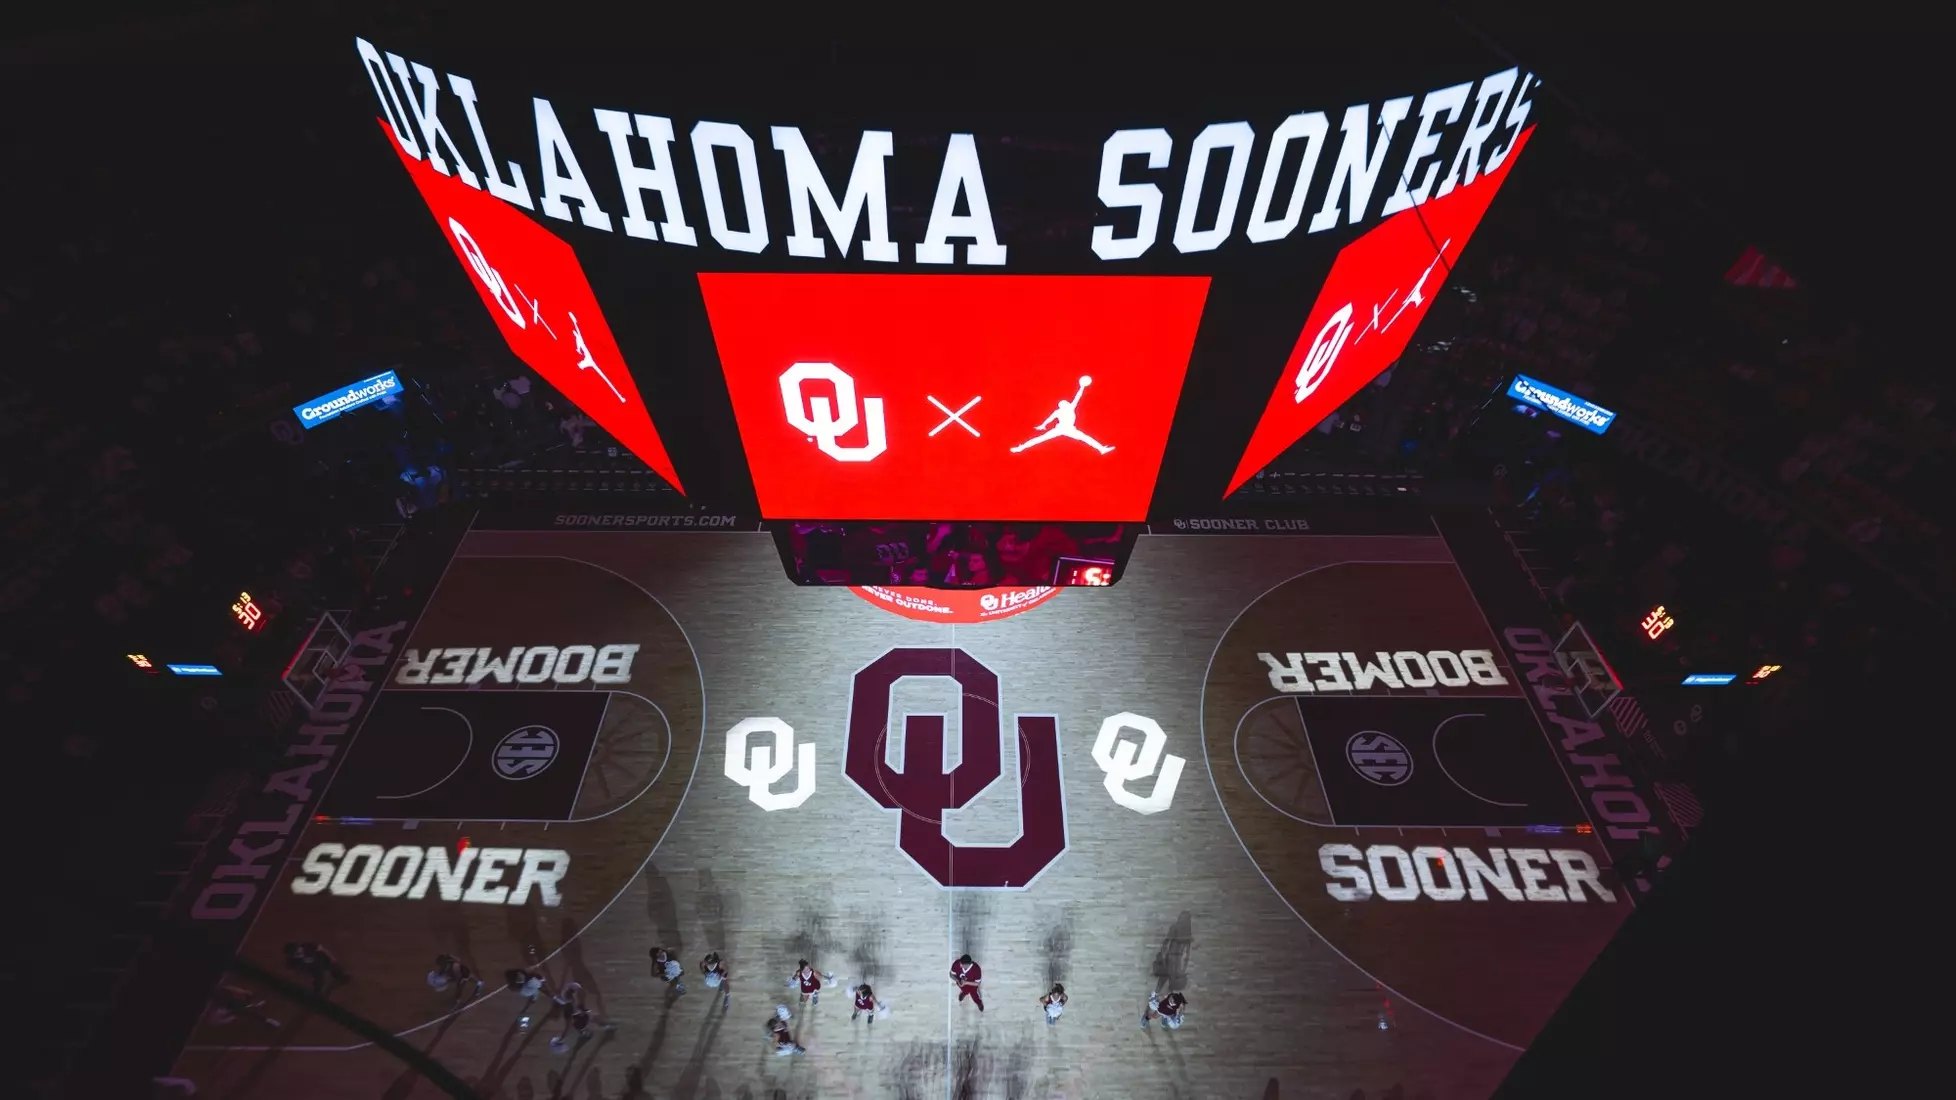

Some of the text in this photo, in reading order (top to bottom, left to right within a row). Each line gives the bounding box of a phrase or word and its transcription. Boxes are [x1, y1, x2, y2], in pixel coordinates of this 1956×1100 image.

[356, 36, 1542, 265] OKLAHOMA SOONERS
[301, 376, 396, 421] Groundworks
[778, 361, 888, 463] OU
[1514, 379, 1609, 427] Groundworks
[554, 514, 736, 527] SOONERSPORTS.COM
[1190, 518, 1260, 530] SOONER
[1265, 519, 1311, 530] CLUB
[238, 602, 262, 630] 30
[1641, 611, 1665, 640] 30
[395, 643, 640, 686] BOOMER
[1257, 648, 1509, 693] BOOMER
[498, 729, 555, 775] SEC
[724, 716, 816, 811] OU
[841, 647, 1070, 890] OU
[1091, 711, 1186, 815] OU
[1352, 735, 1408, 781] SEC
[291, 842, 570, 907] SOONER
[1318, 843, 1617, 903] SOONER
